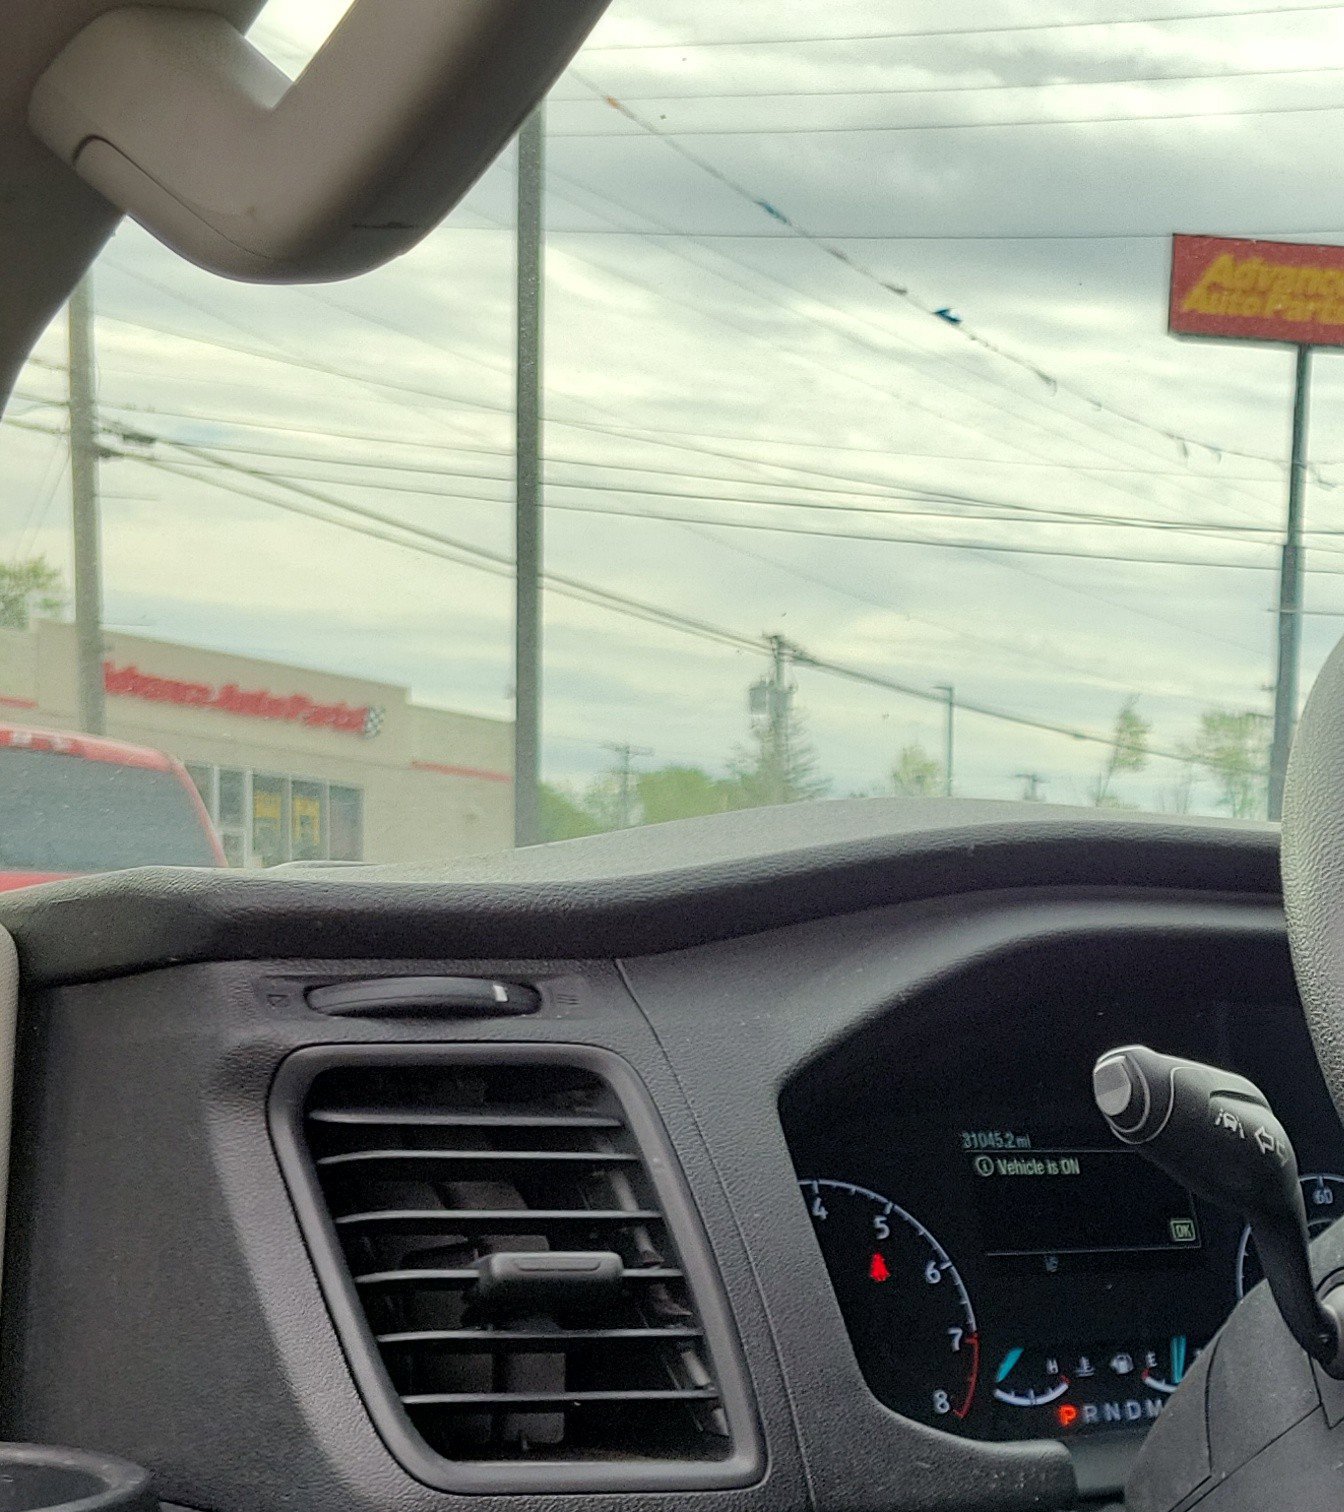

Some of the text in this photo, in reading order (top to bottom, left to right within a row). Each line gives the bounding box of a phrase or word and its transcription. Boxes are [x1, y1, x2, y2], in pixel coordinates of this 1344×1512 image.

[997, 1158, 1045, 1176] Vehicle
[1060, 1157, 1081, 1175] ON
[811, 1198, 829, 1220] 4
[873, 1215, 890, 1239] 5
[925, 1260, 942, 1284] 6
[948, 1327, 963, 1351] 7
[933, 1389, 950, 1414] 8
